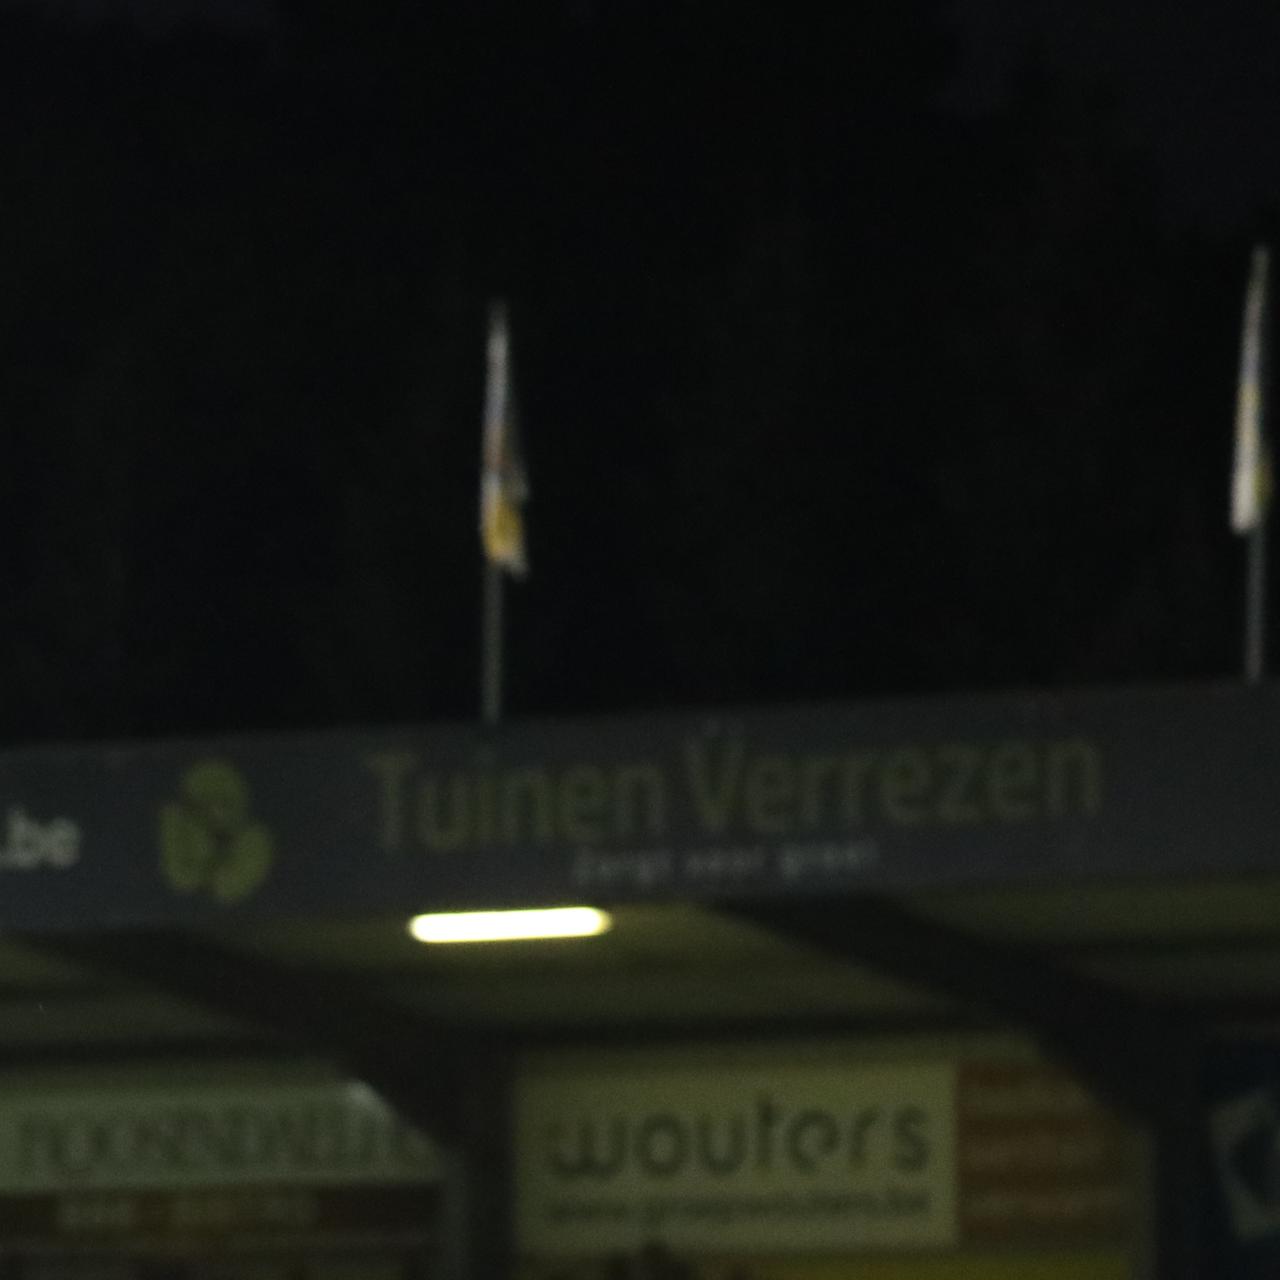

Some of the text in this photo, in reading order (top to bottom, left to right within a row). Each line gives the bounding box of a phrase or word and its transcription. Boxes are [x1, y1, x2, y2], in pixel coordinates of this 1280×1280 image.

[365, 736, 1102, 852] Tuinen Verrezen
[546, 1093, 930, 1180] wouters
